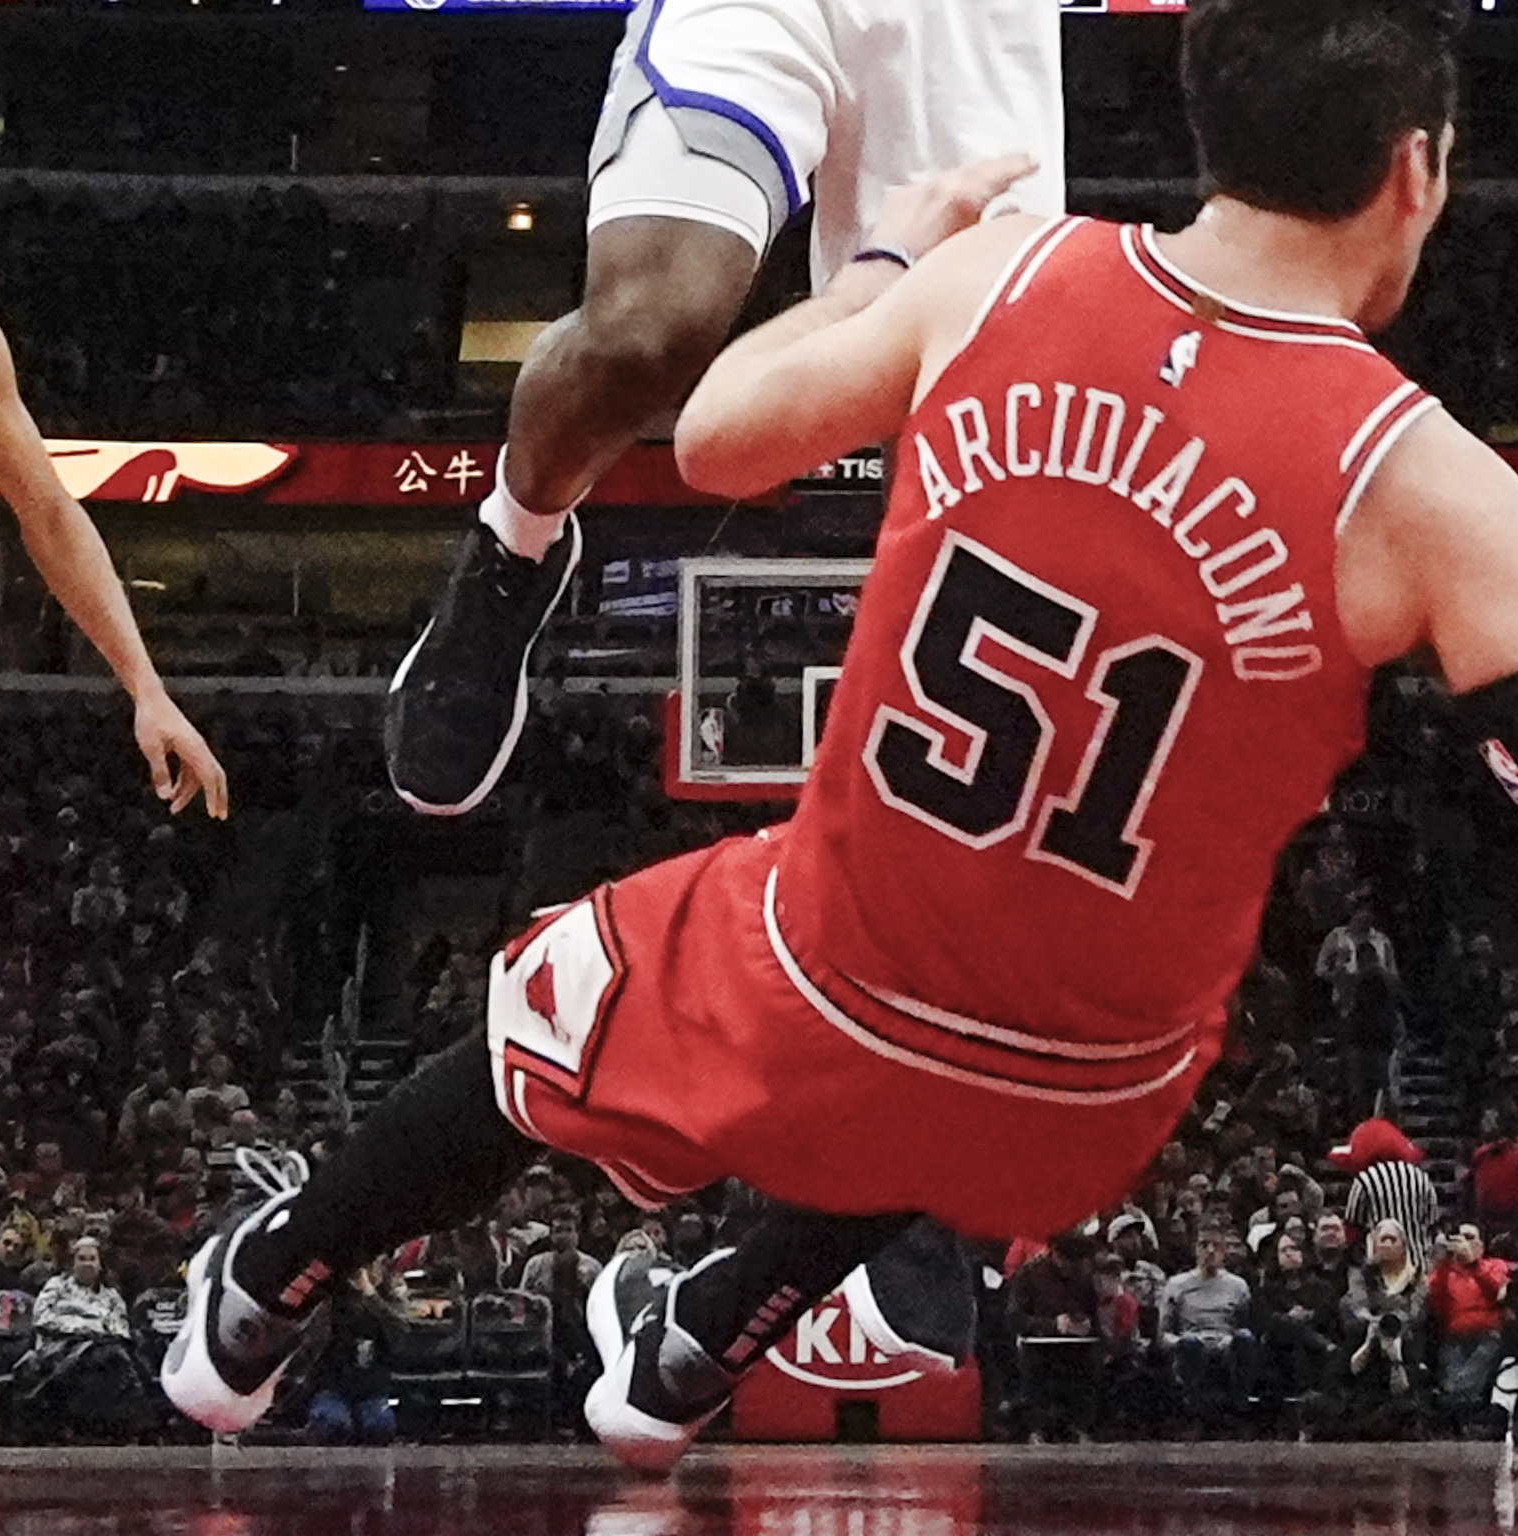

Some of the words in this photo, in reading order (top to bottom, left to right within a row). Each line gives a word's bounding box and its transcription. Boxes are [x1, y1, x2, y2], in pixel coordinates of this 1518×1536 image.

[393, 450, 484, 495] 公牛
[912, 381, 1323, 681] ARCIDIACONO
[862, 528, 1204, 901] 51
[795, 1306, 889, 1364] KI
